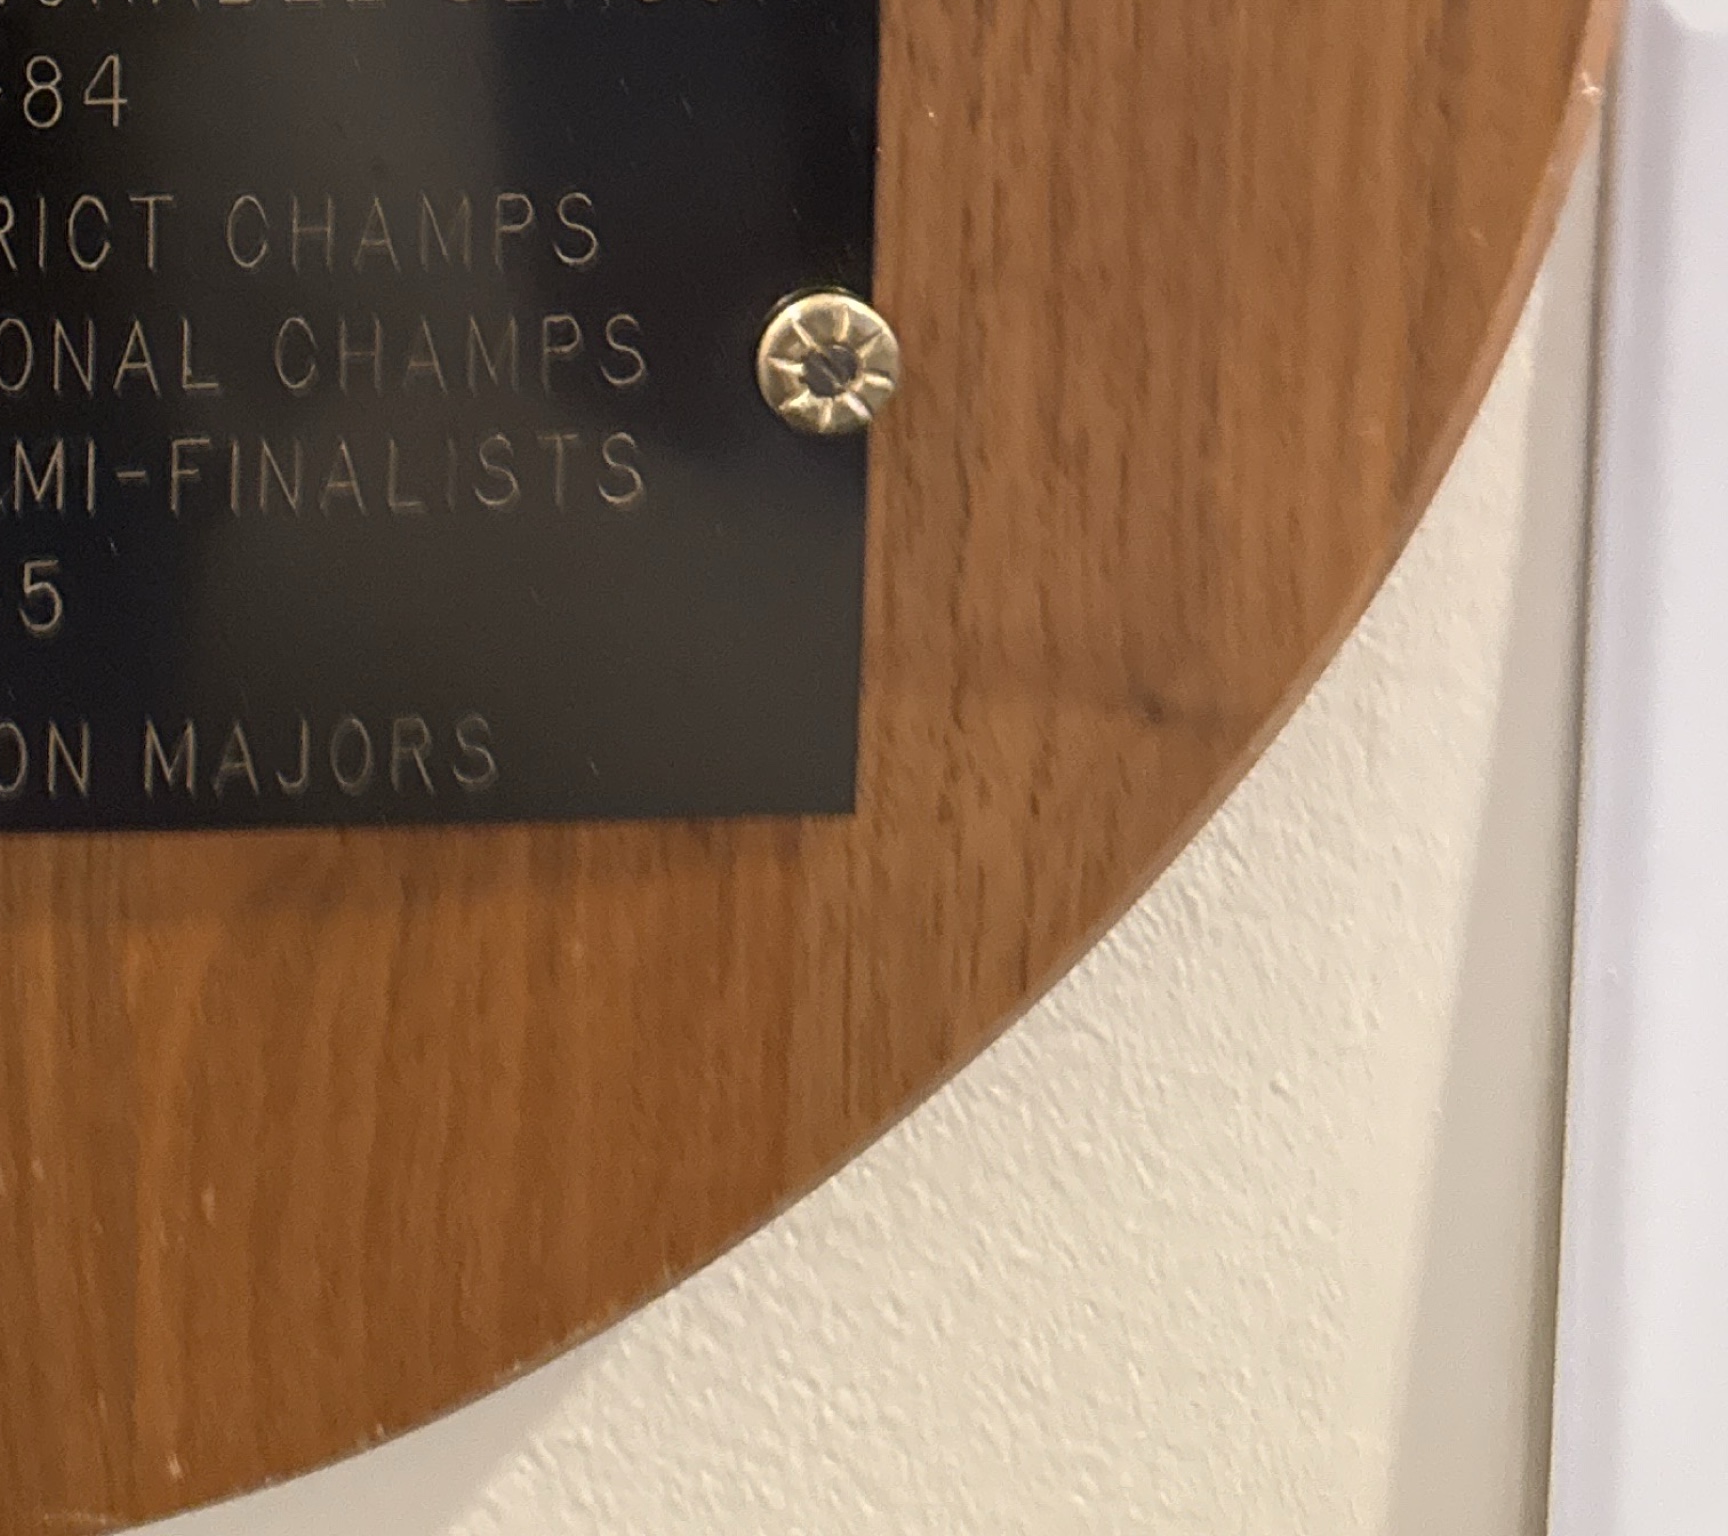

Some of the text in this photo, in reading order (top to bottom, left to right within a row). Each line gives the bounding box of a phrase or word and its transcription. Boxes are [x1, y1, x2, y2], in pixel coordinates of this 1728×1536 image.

[224, 192, 600, 271] CHAMPS
[273, 313, 650, 394] CHAMPS
[143, 715, 500, 797] MAJORS
